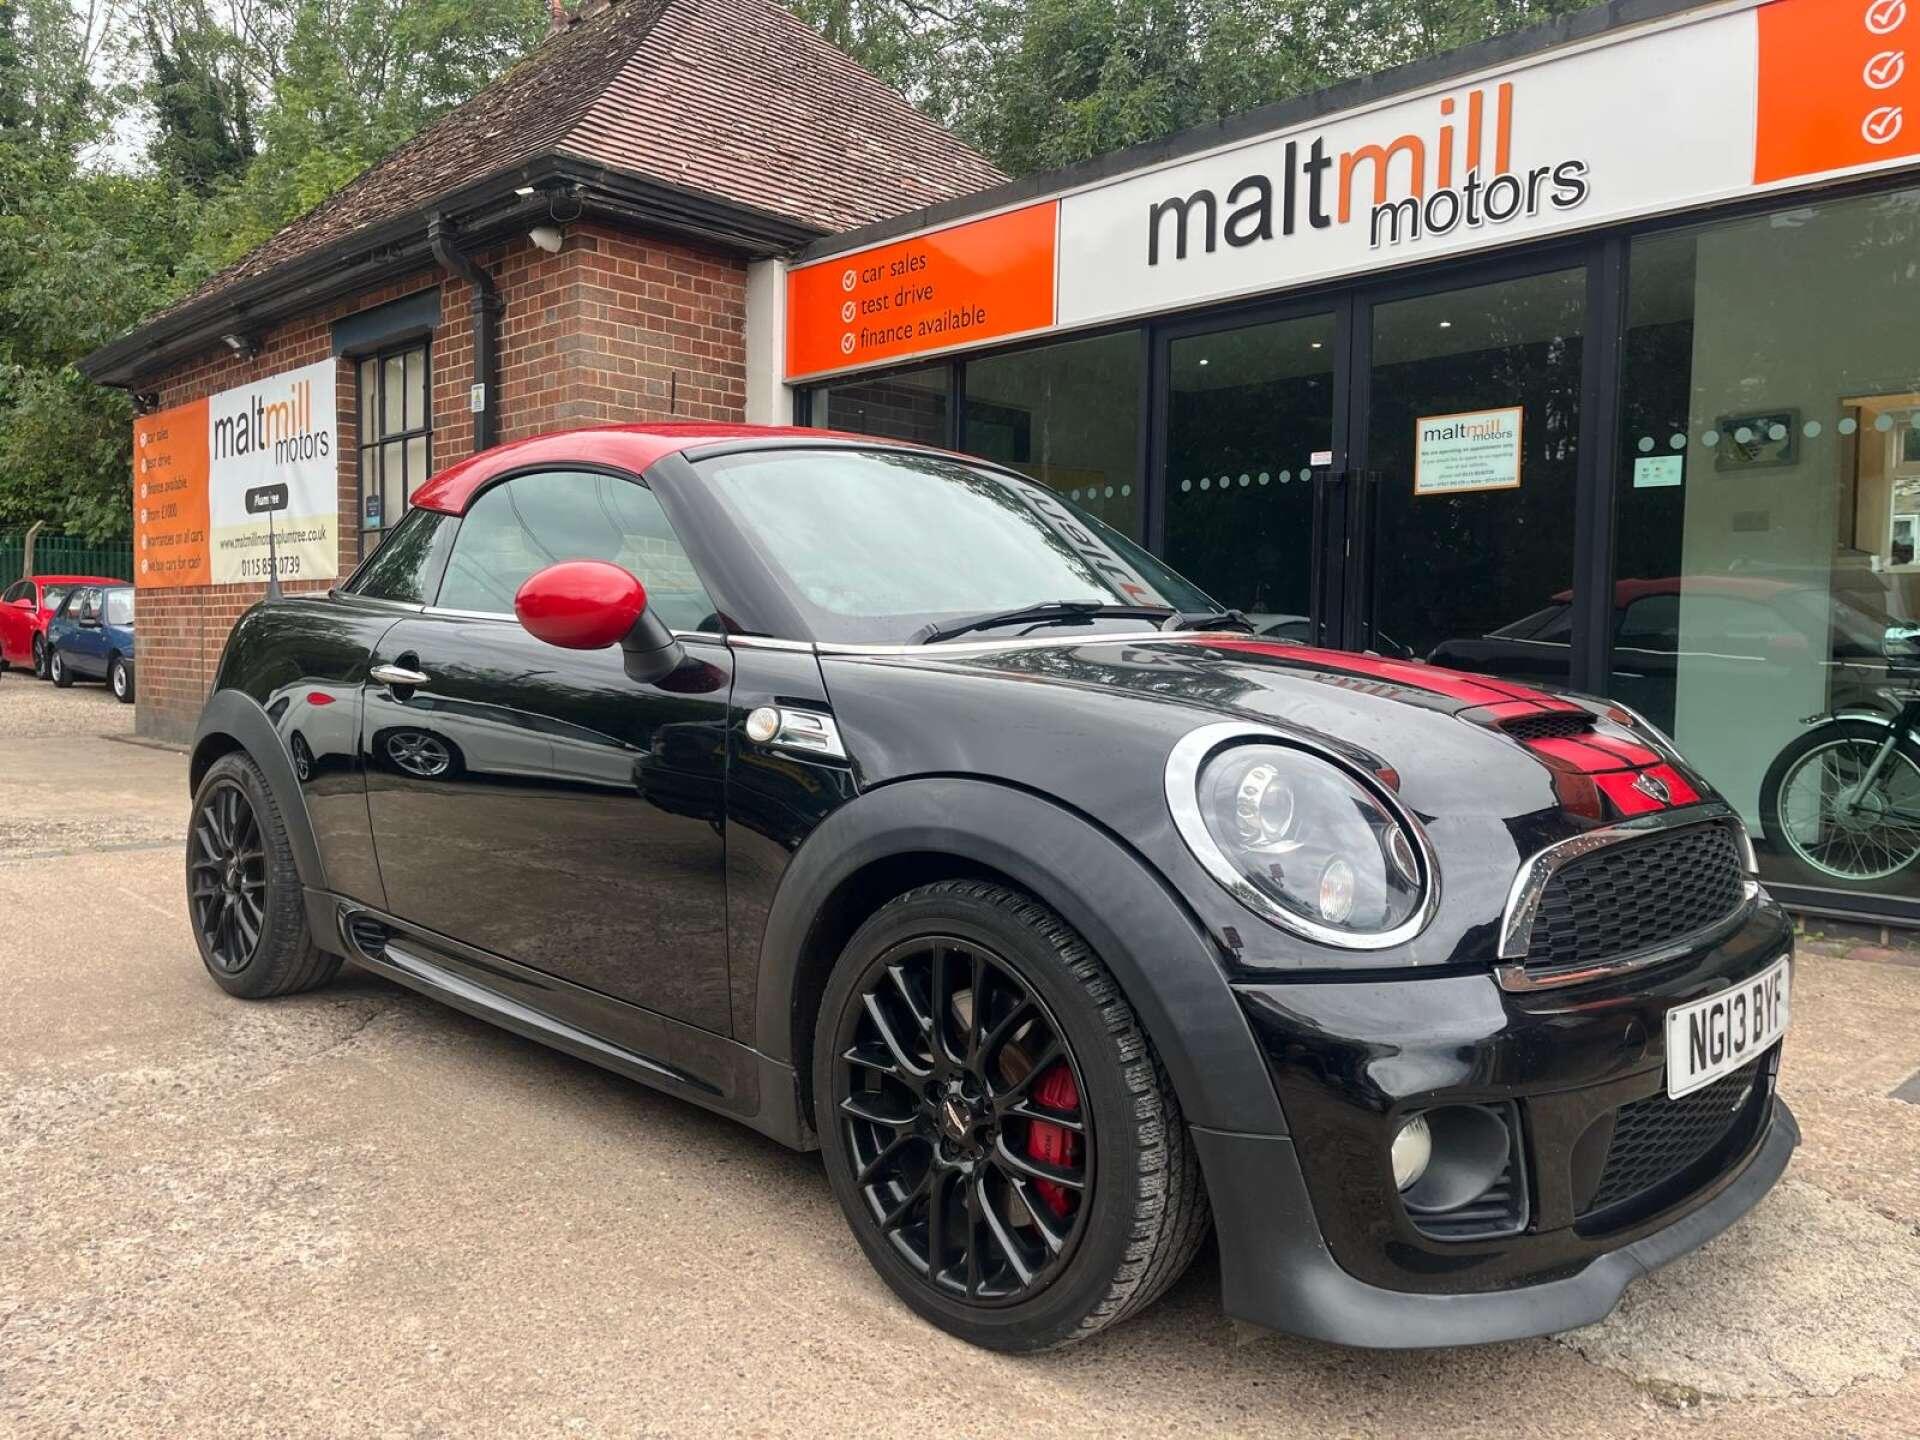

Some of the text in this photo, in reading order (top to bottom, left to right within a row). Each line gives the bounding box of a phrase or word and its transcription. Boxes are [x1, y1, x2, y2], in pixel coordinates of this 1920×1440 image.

[1368, 158, 1589, 249] motors
[861, 252, 926, 284] car sales
[860, 284, 934, 315] test drive
[860, 304, 986, 349] finance available
[275, 429, 330, 465] motors
[1473, 430, 1513, 442] motors
[241, 558, 261, 577] 0115
[279, 555, 301, 574] 0739
[1689, 969, 1782, 1075] NG13 BYF
